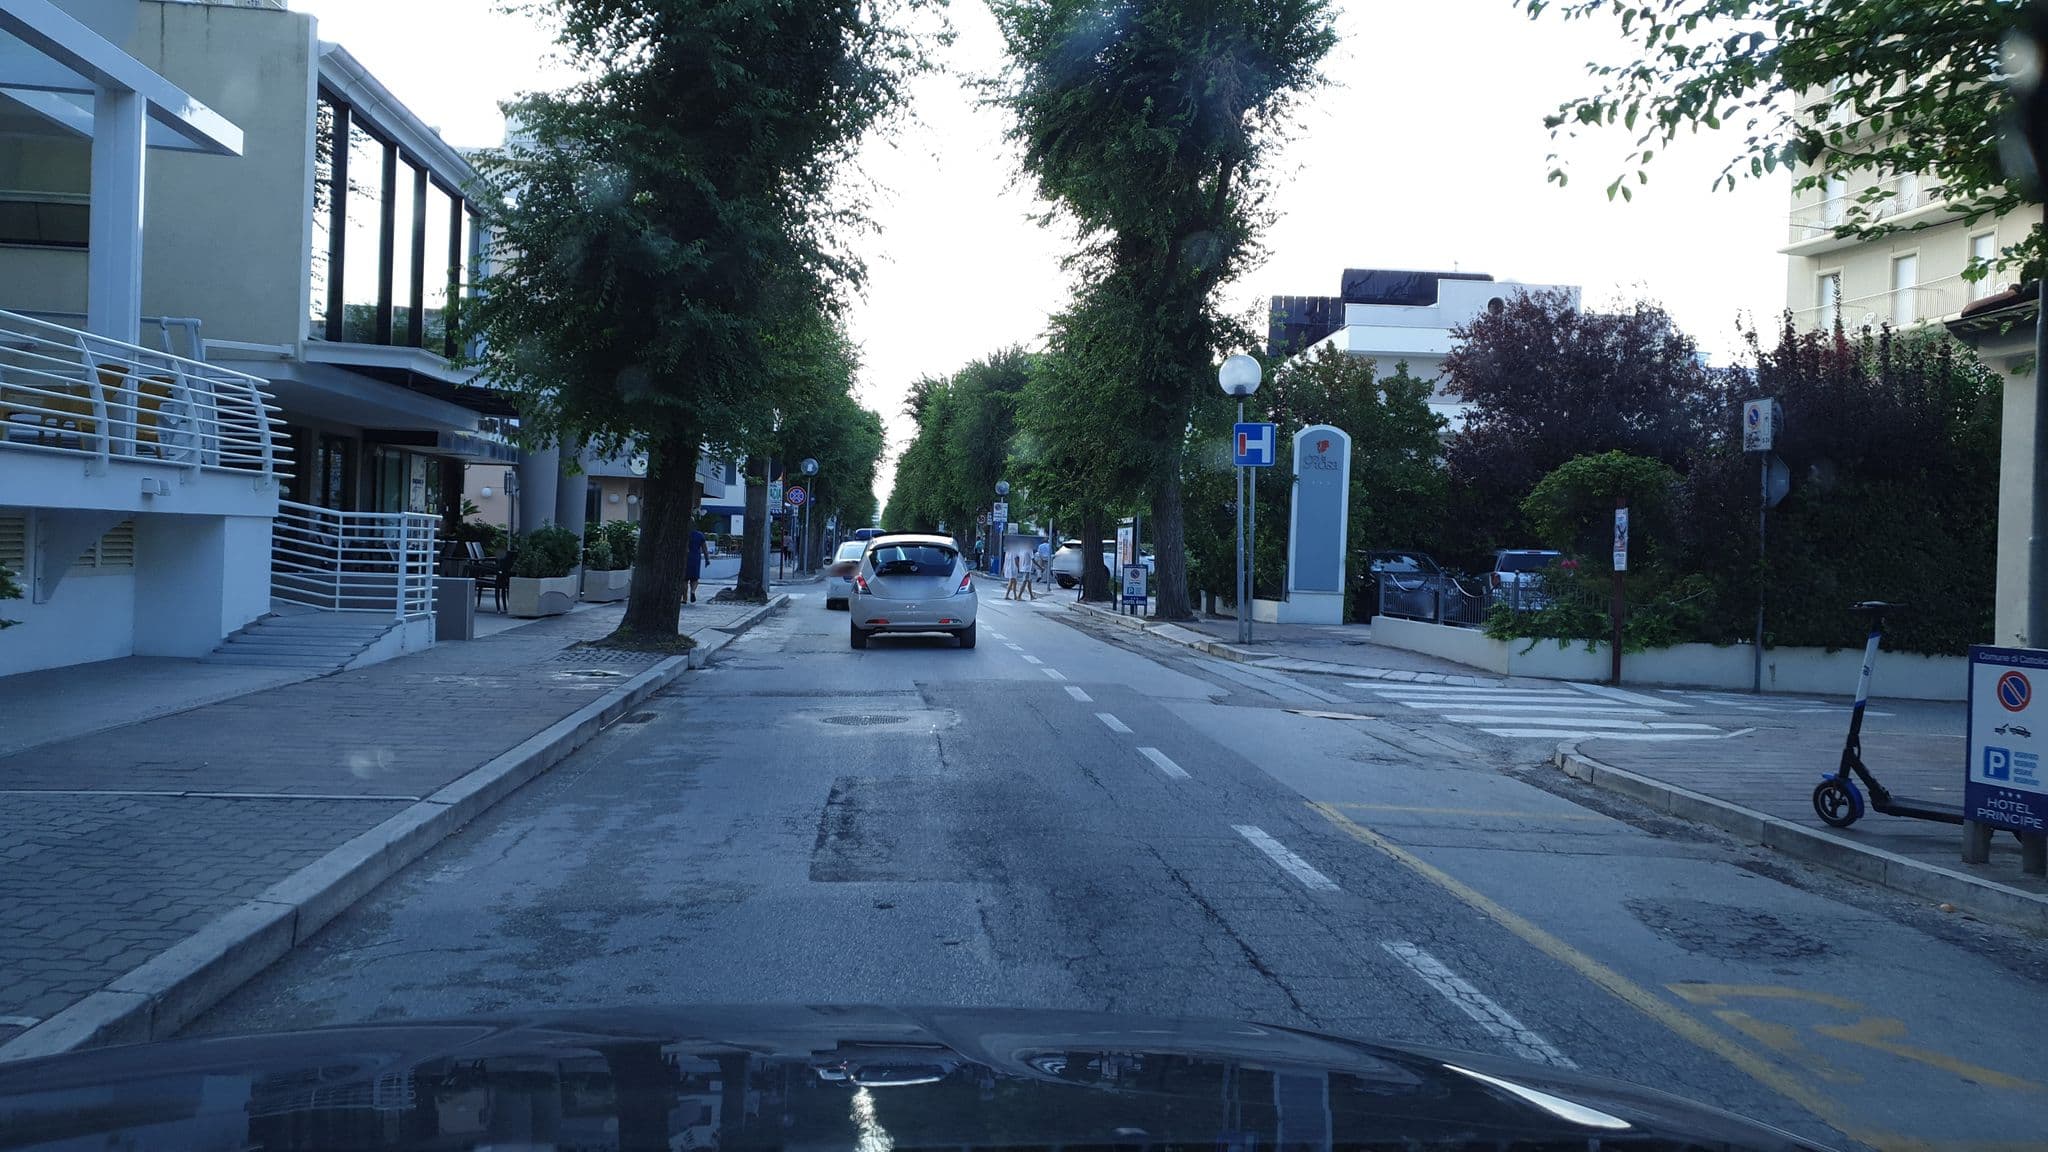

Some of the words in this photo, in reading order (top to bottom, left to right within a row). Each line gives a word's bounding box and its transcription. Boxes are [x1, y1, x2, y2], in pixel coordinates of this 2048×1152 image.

[1979, 652, 2010, 662] Comune
[2011, 654, 2019, 663] di
[1988, 750, 2006, 775] P
[1987, 797, 2034, 816] HOTEL
[1977, 807, 2044, 830] PRINCIPE
